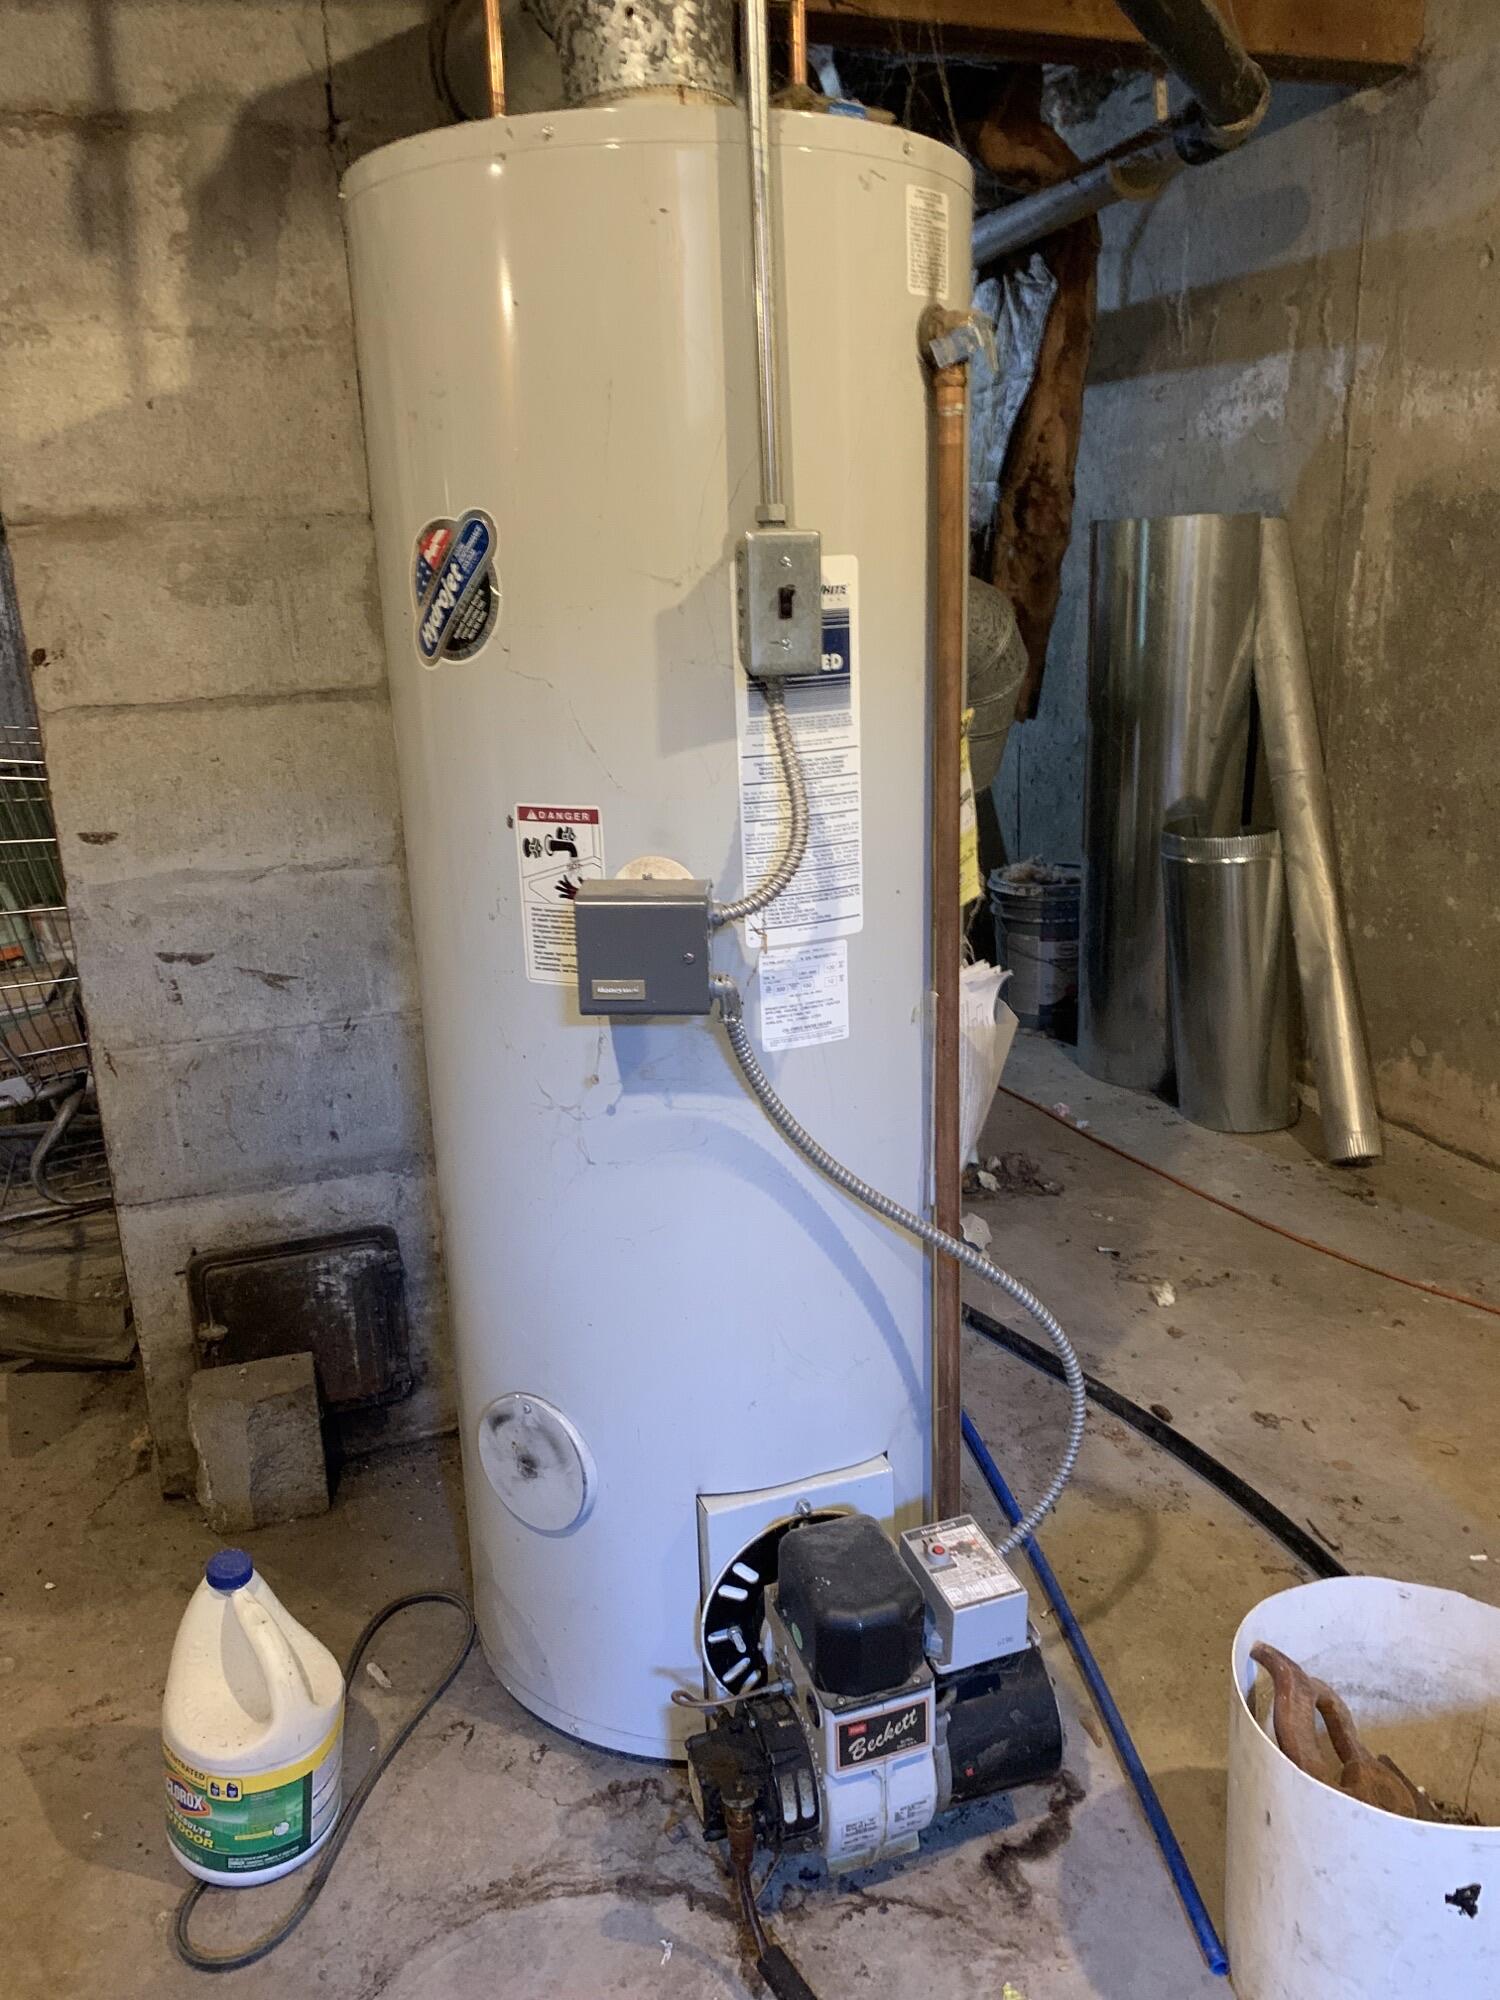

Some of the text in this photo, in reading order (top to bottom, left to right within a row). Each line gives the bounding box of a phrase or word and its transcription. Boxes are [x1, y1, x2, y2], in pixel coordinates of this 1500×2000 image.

[821, 584, 847, 595] HITE
[821, 652, 844, 671] ED
[538, 810, 590, 822] DANGER
[848, 1708, 918, 1761] Beckett
